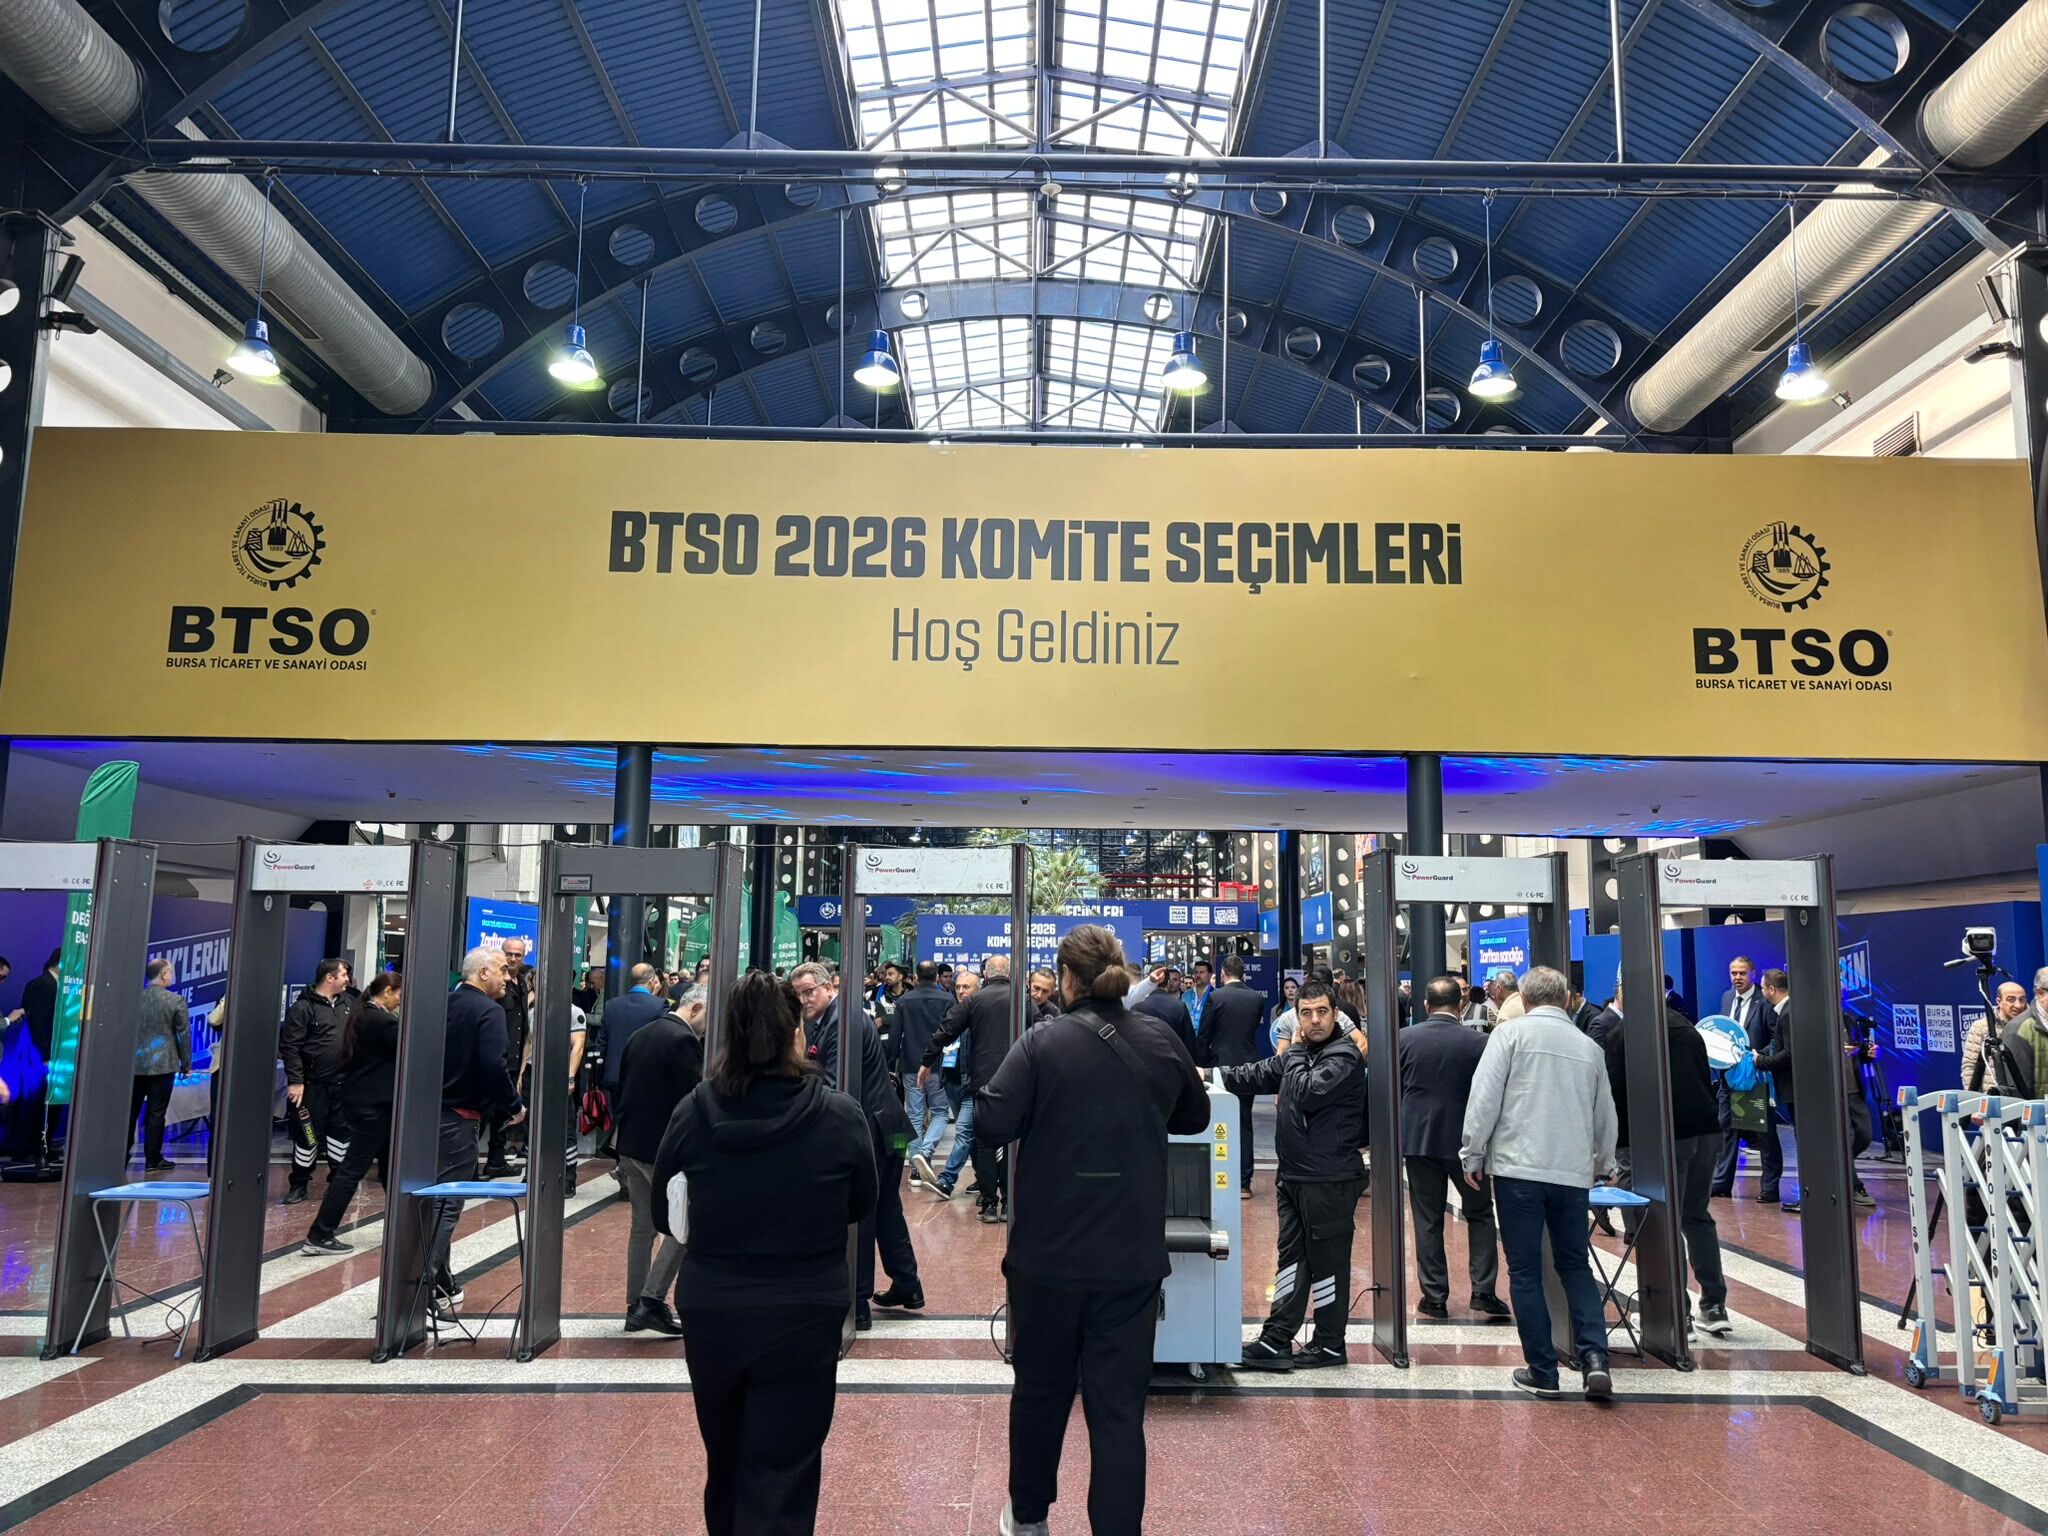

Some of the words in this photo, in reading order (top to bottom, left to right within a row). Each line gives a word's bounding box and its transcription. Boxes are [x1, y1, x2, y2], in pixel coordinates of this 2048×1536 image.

[609, 510, 760, 576] BTSO
[774, 515, 927, 579] 2026
[941, 517, 1151, 583] KOMİTE
[1166, 521, 1463, 595] SEÇİMLERİ
[168, 605, 370, 657] BTSO
[892, 607, 981, 672] Hoş
[997, 608, 1180, 666] Geldiniz
[1693, 627, 1889, 677] BTSO
[166, 657, 207, 669] BURSA
[210, 656, 261, 669] TİCARET
[264, 659, 280, 670] VE
[282, 657, 327, 670] SANAYİ
[330, 660, 368, 671] ODASI
[1695, 678, 1735, 689] BURSA
[1738, 677, 1787, 690] TİCARET
[1790, 680, 1806, 690] VE
[1808, 678, 1852, 691] SANAYİ
[1855, 681, 1892, 691] ODASI
[1031, 923, 1056, 935] 2026
[935, 936, 963, 945] BTSO
[1251, 963, 1262, 971] WC
[1927, 1007, 1951, 1017] BURSA
[1896, 1015, 1918, 1027] İNAN
